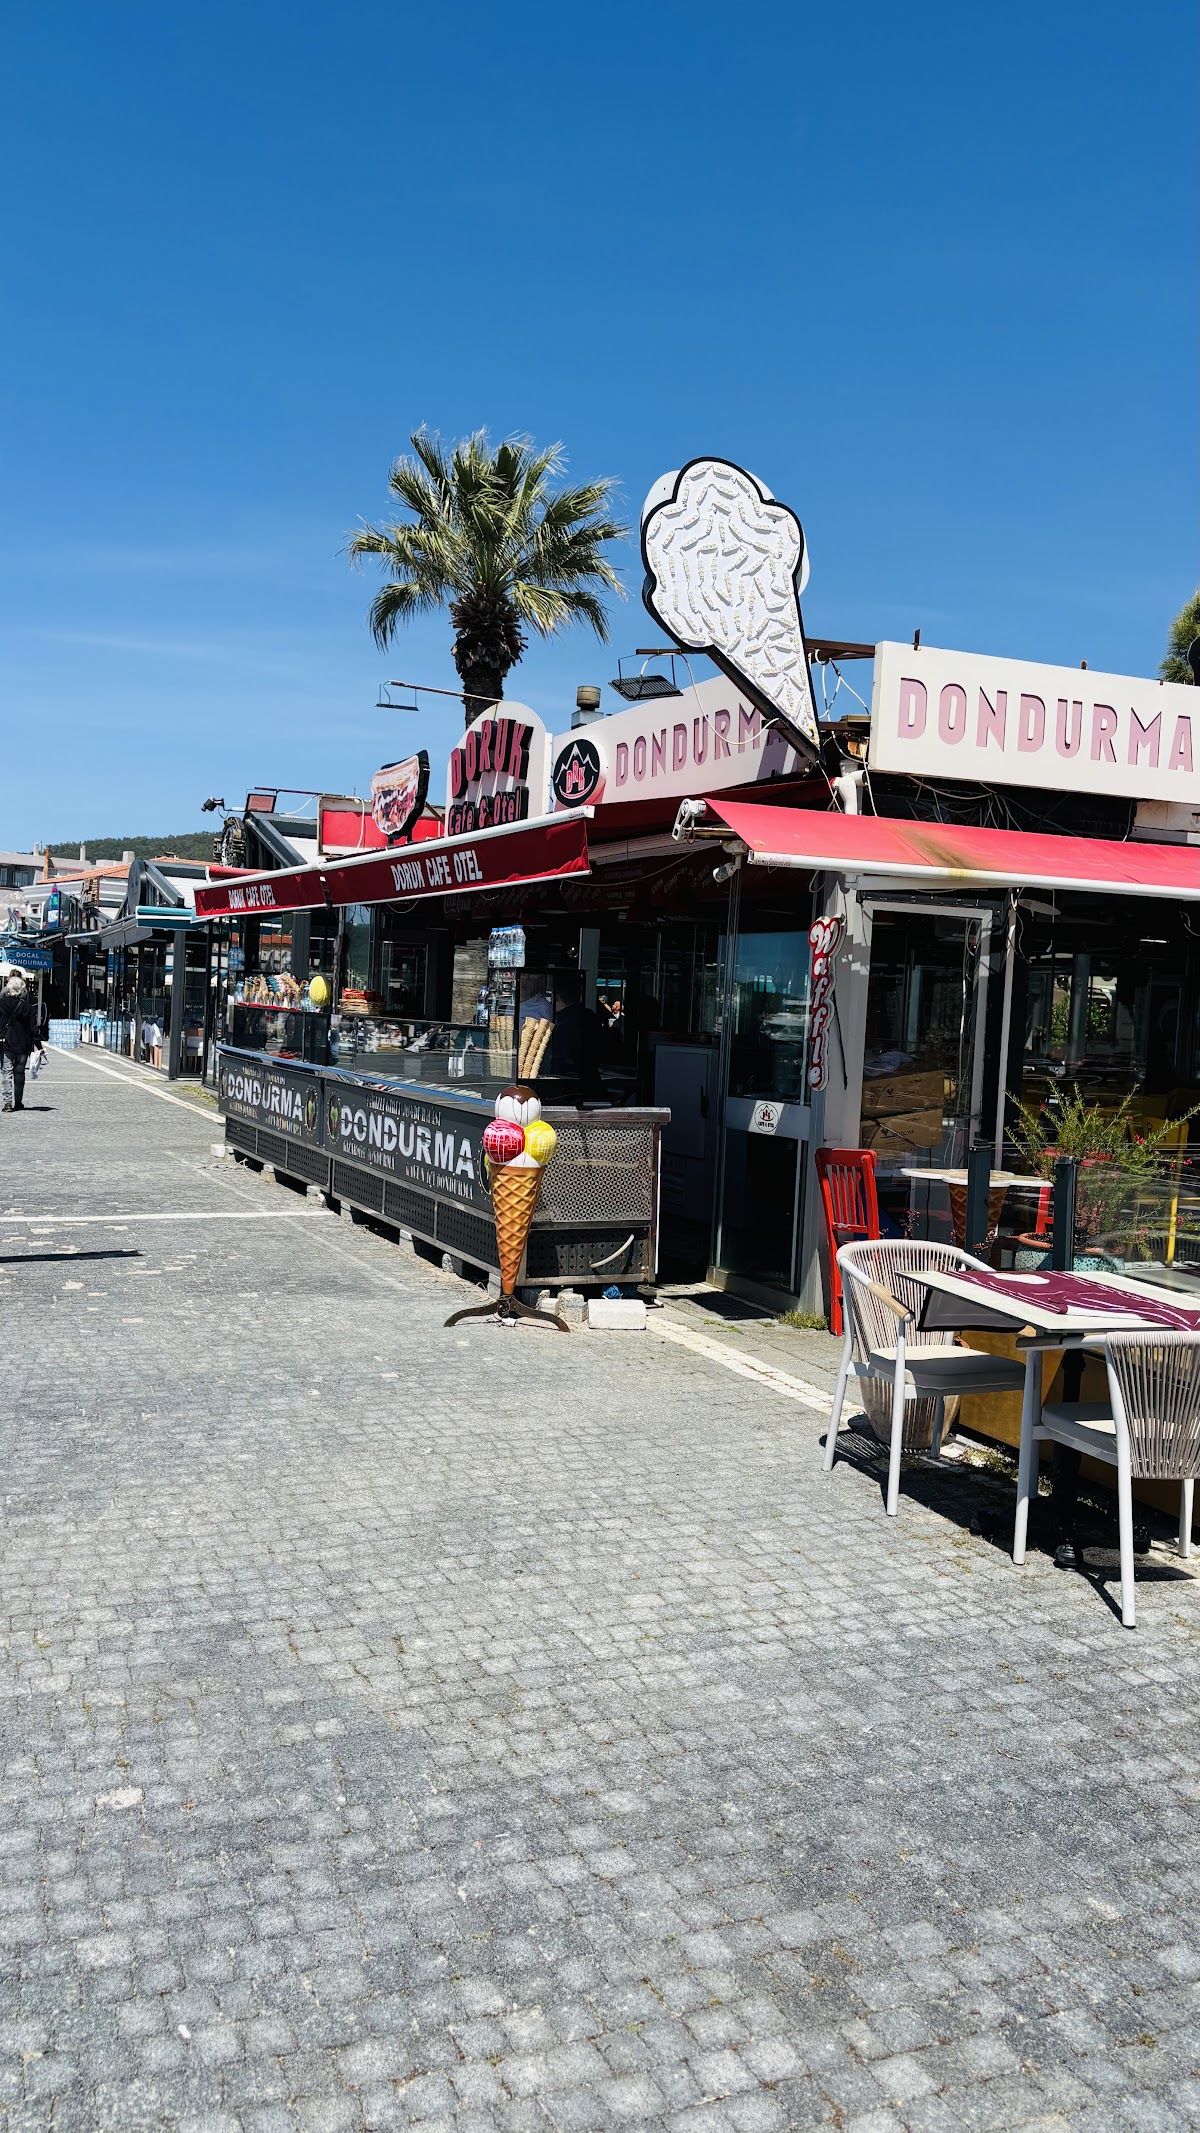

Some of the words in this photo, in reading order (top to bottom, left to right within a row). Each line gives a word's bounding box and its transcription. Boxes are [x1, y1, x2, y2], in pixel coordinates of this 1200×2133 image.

[897, 676, 1194, 773] DONDURMA
[451, 718, 530, 798] DORUK
[566, 760, 585, 793] DRK
[448, 801, 475, 836] Cafe
[493, 785, 521, 825] Otel
[391, 861, 425, 892] DORUK
[425, 855, 452, 887] CAFE
[453, 850, 482, 882] OTEL
[245, 886, 260, 907] CAFE
[8, 958, 48, 967] DONDURMA
[809, 919, 839, 1088] Waffle
[228, 1072, 303, 1122] DONDURMA
[340, 1104, 475, 1180] DONDURMA
